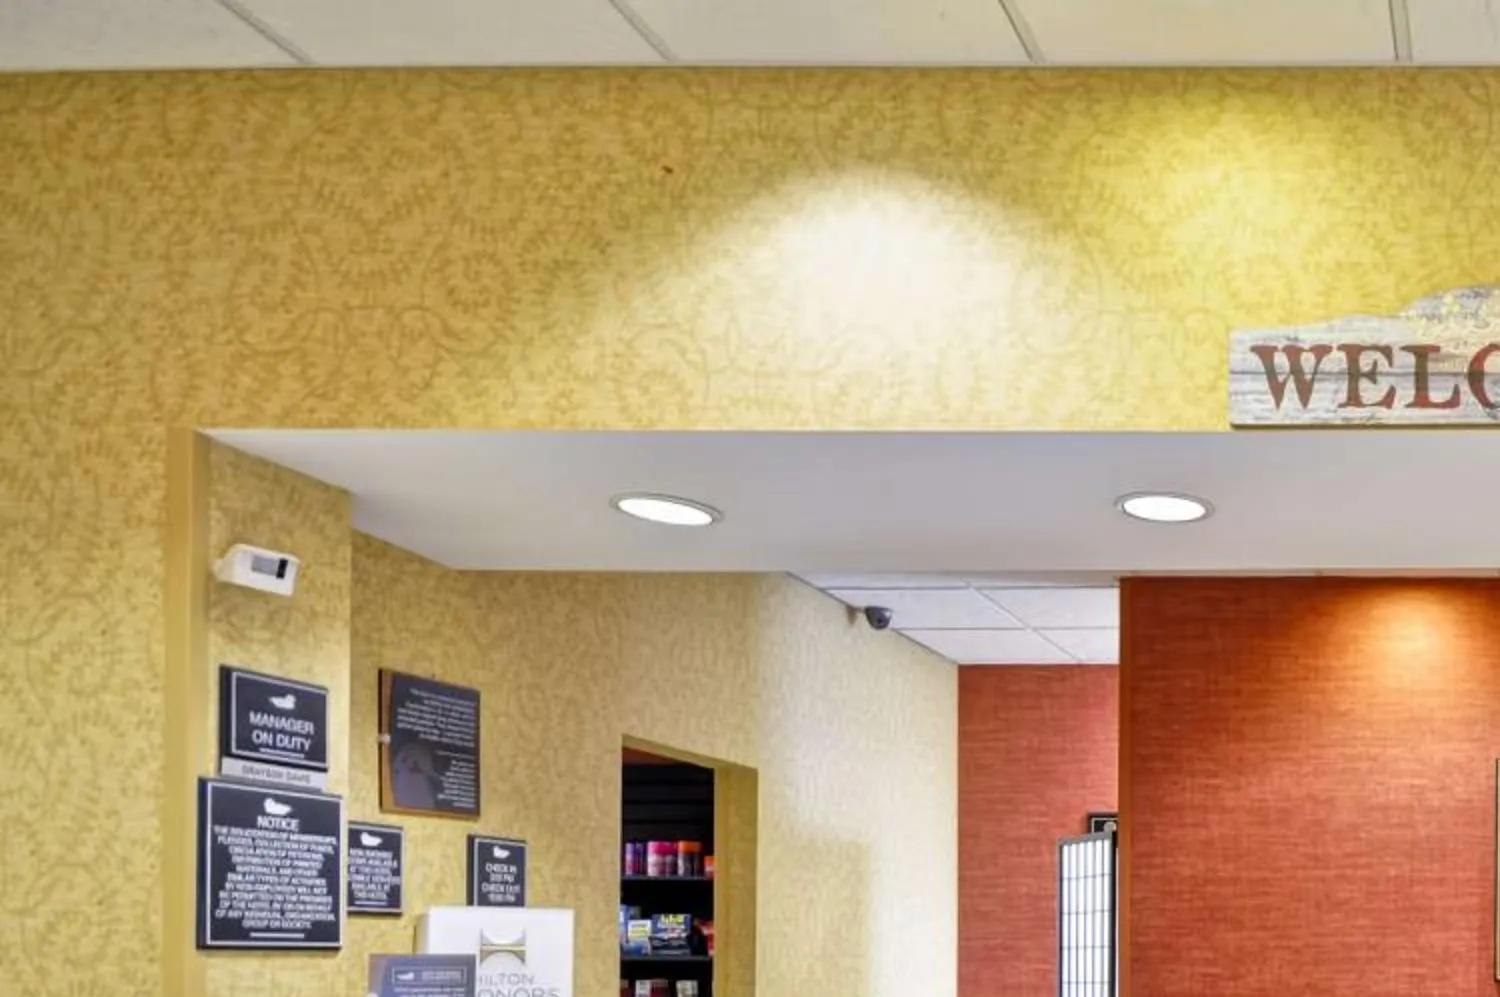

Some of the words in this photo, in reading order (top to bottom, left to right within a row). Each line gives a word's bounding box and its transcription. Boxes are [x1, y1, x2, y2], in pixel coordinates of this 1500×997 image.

[249, 711, 314, 734] MANAGER
[252, 729, 273, 746] ON
[276, 733, 312, 751] DUTY
[257, 815, 299, 832] NOTICE
